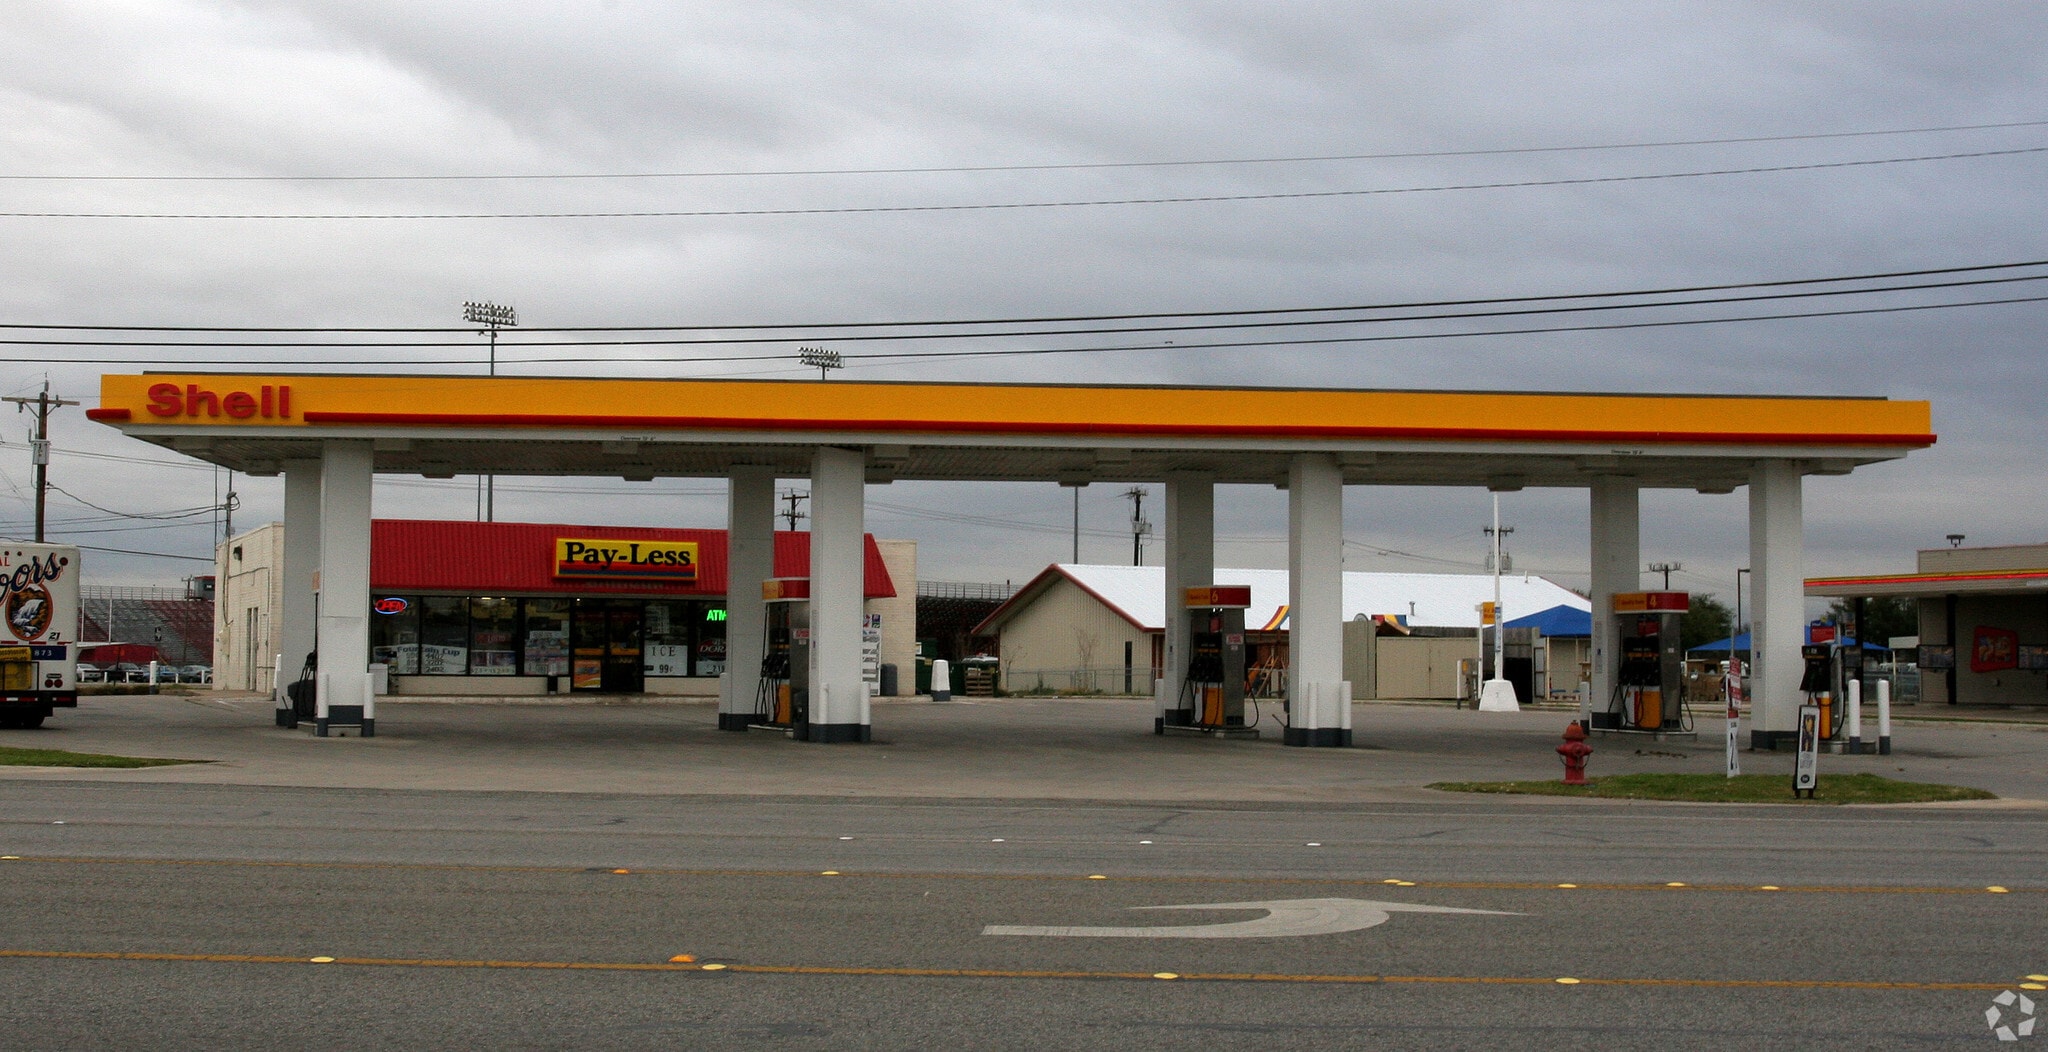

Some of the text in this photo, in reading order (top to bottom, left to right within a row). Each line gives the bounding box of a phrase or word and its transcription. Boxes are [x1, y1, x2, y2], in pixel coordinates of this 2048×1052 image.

[146, 383, 292, 419] Shell
[564, 541, 691, 570] Pay-Less
[0, 552, 63, 602] oors
[1211, 591, 1219, 602] 6
[1649, 595, 1657, 608] 4
[375, 599, 405, 613] OPEN
[48, 632, 60, 641] 21
[397, 646, 460, 657] Founain Cup
[651, 646, 676, 657] ICE
